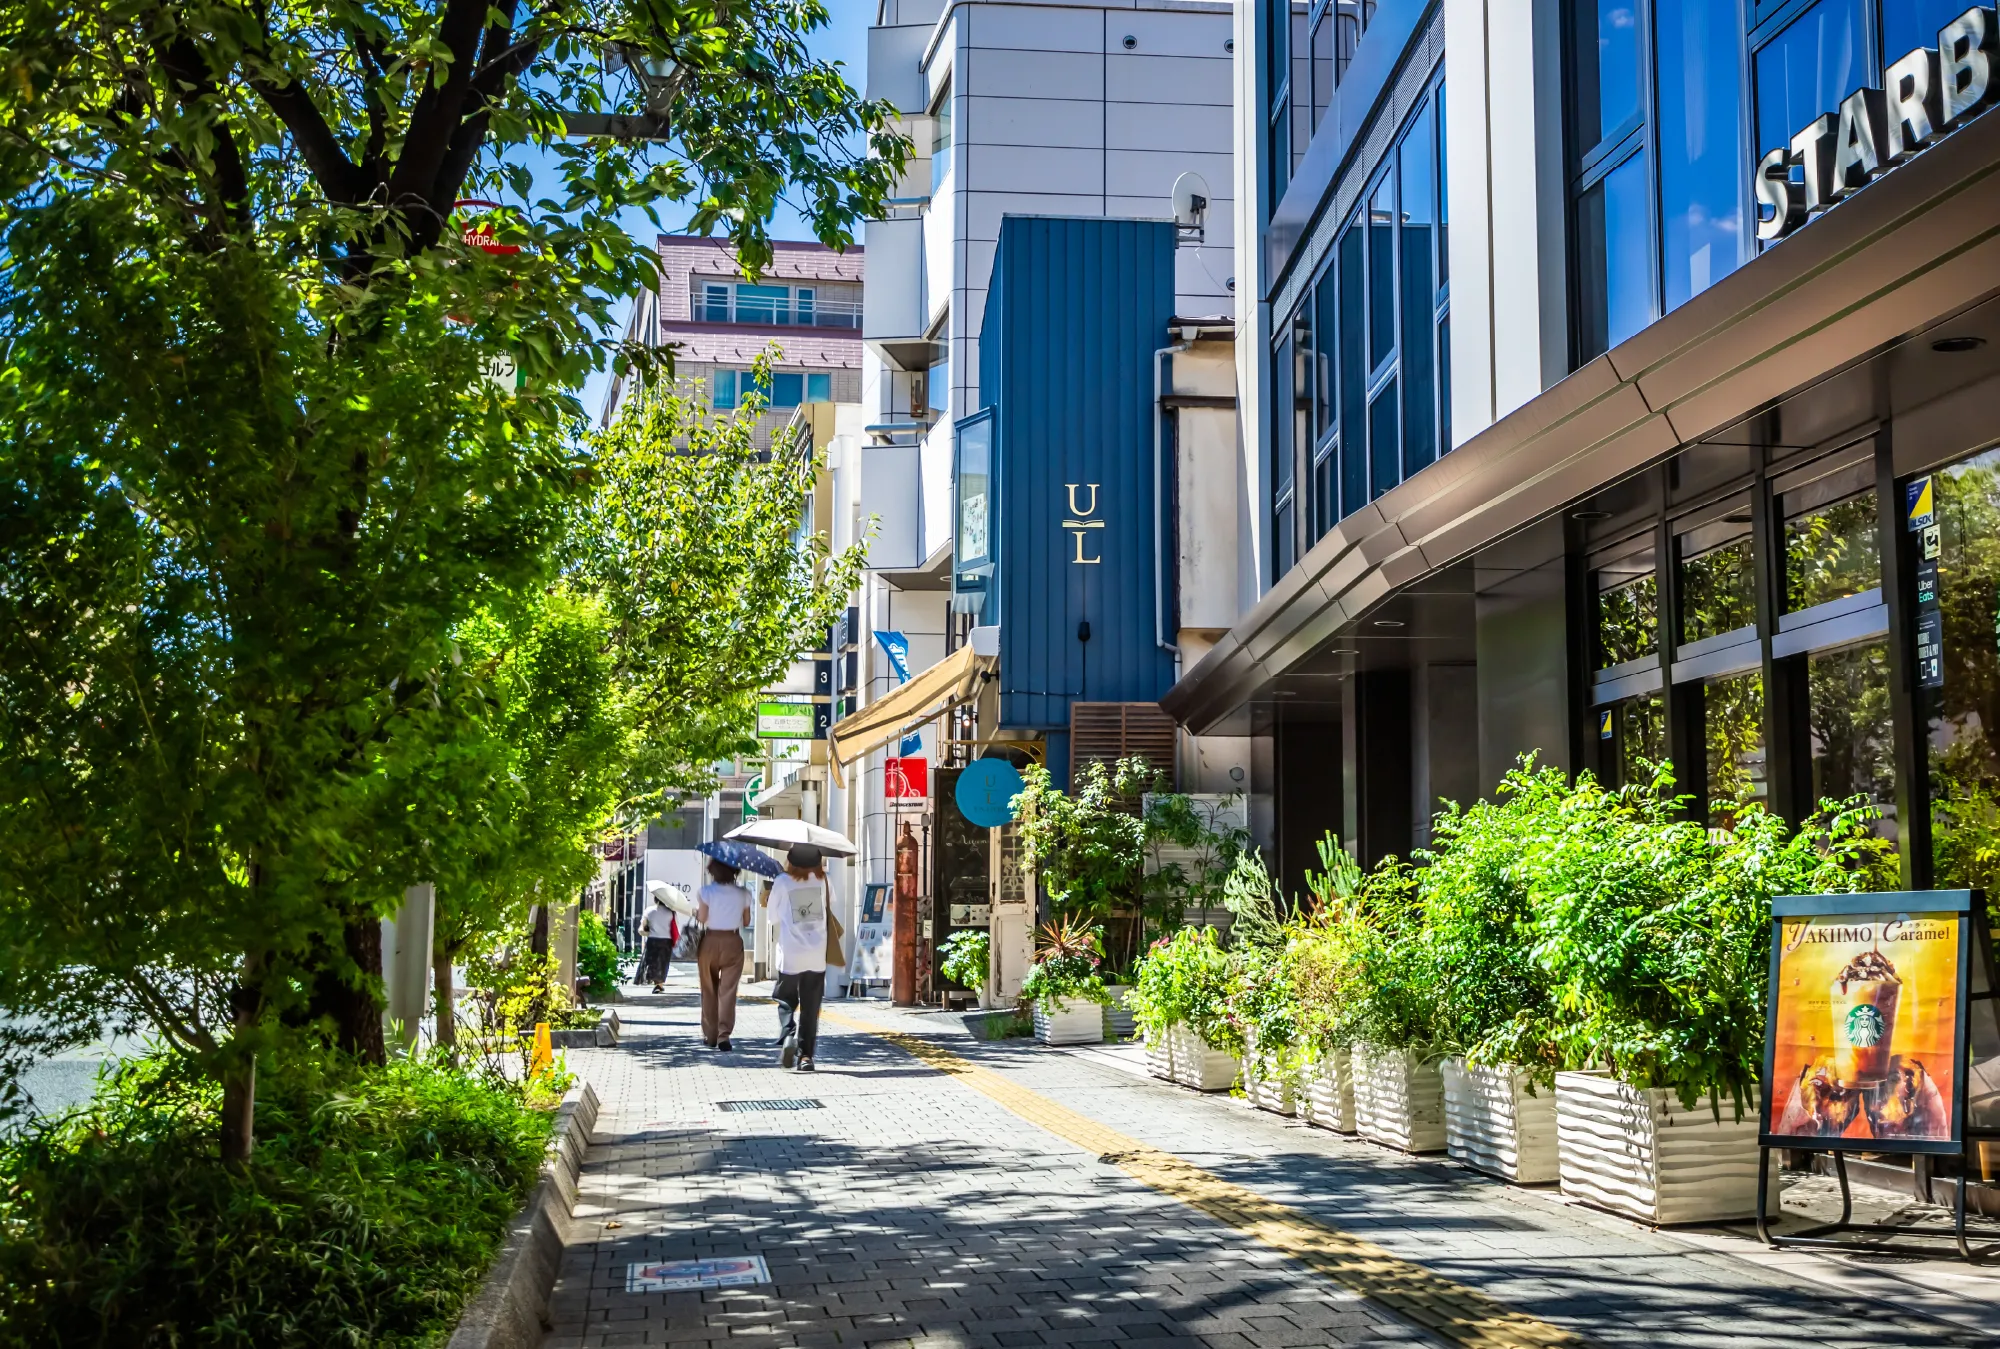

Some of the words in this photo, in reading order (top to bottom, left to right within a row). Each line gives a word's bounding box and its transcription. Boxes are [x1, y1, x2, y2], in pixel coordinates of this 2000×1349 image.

[1754, 6, 1998, 240] STARB
[463, 235, 503, 247] HYDRA
[1064, 483, 1100, 516] U
[1072, 531, 1101, 564] L
[1918, 580, 1934, 591] Uber
[1919, 591, 1934, 603] Eats
[820, 671, 828, 684] 3
[820, 715, 827, 727] 2
[1787, 921, 1872, 951] YAKIIMO
[1883, 920, 1950, 942] Caramel
